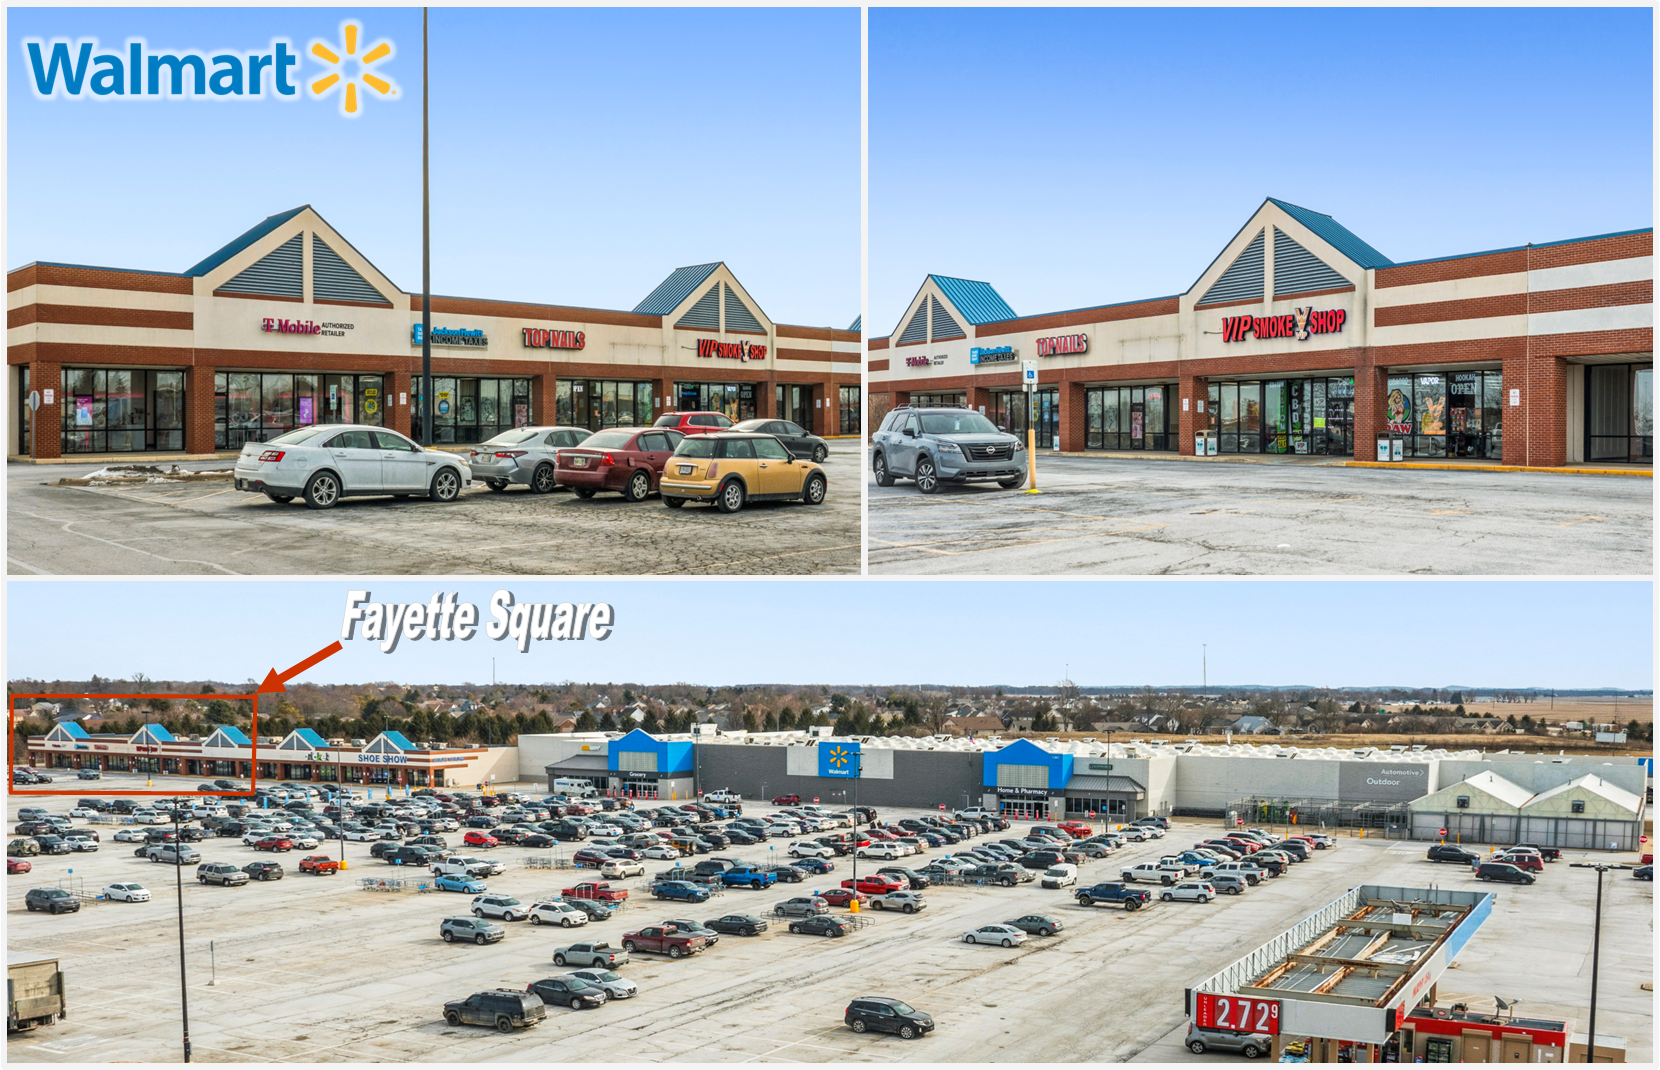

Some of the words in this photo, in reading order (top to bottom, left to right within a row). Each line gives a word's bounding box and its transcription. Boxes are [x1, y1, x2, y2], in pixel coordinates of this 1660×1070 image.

[321, 322, 355, 330] AUTHORIZED
[1221, 315, 1253, 343] VIP
[1253, 314, 1295, 339] SMOKE
[1309, 309, 1347, 334] SHOP
[430, 335, 464, 346] INCOME
[464, 336, 488, 347] TAXES
[522, 328, 549, 348] TOP
[549, 329, 586, 350] NAILS
[697, 338, 718, 358] VIP
[718, 342, 742, 359] SMOKE
[750, 344, 768, 360] SHOP
[1036, 338, 1056, 357] TOP
[1055, 333, 1088, 356] NAILS
[1420, 377, 1440, 385] VAPOR
[1455, 373, 1476, 382] HOOKAH
[1451, 382, 1477, 395] OPEN
[358, 754, 381, 763] SHOE
[382, 754, 408, 764] SHOW
[1366, 777, 1400, 786] Outdoor
[1020, 787, 1048, 796] Pharmacy
